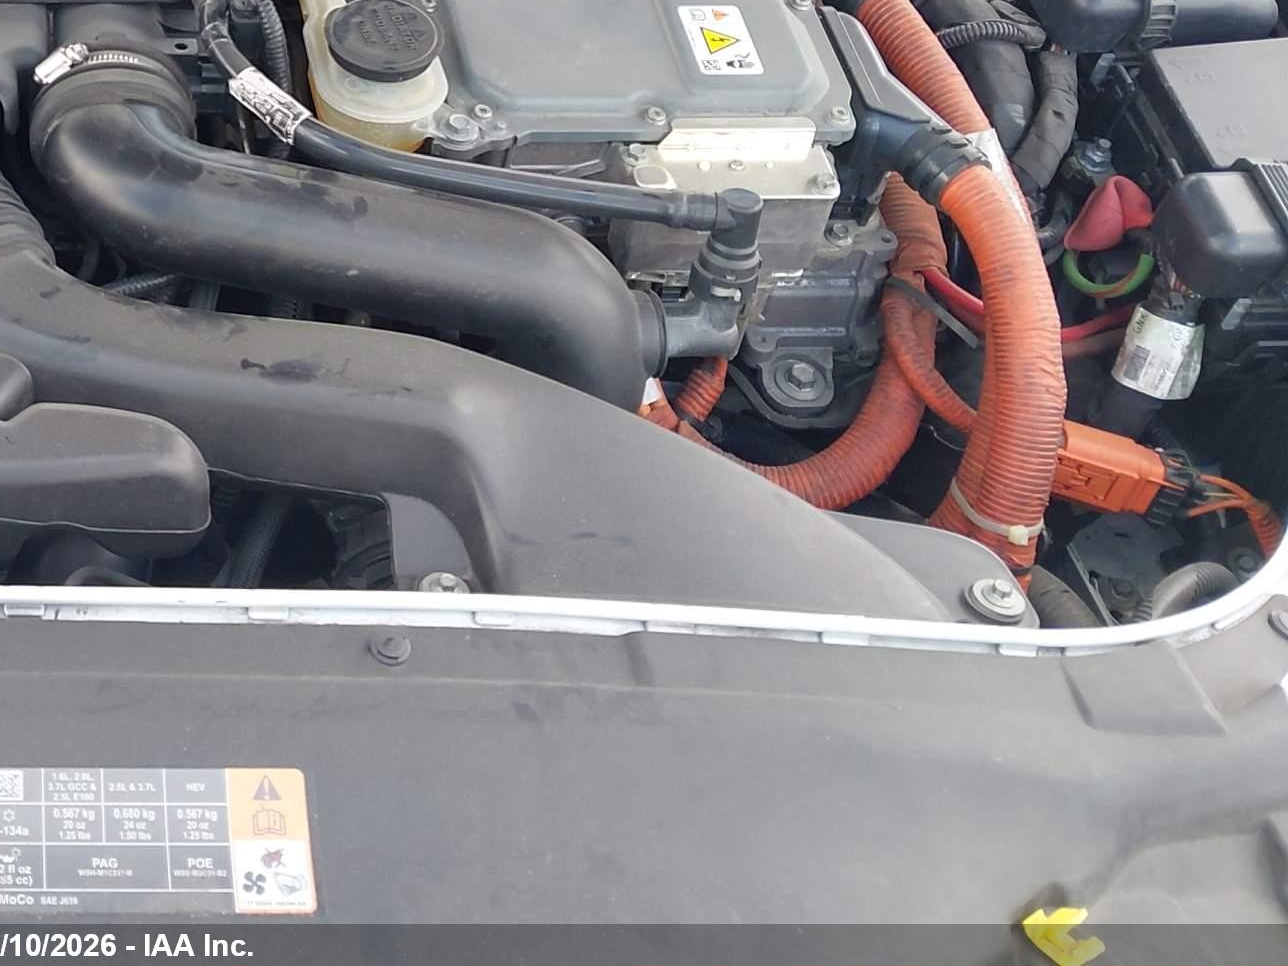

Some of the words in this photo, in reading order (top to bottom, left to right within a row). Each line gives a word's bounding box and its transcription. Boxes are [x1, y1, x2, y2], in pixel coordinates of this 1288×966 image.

[129, 783, 136, 792] &
[53, 807, 80, 819] 0.567
[82, 807, 95, 821] kg
[114, 808, 140, 819] 0.680
[142, 808, 156, 822] kg
[177, 808, 203, 819] 0.567
[204, 808, 218, 822] kg
[75, 822, 86, 830] oz
[136, 822, 147, 830] oz
[198, 822, 209, 830] oz
[92, 857, 118, 868] PAG
[187, 857, 213, 868] POE
[7, 864, 16, 874] fl
[18, 864, 32, 874] oz
[16, 875, 33, 886] cc)
[40, 896, 58, 906] SAE
